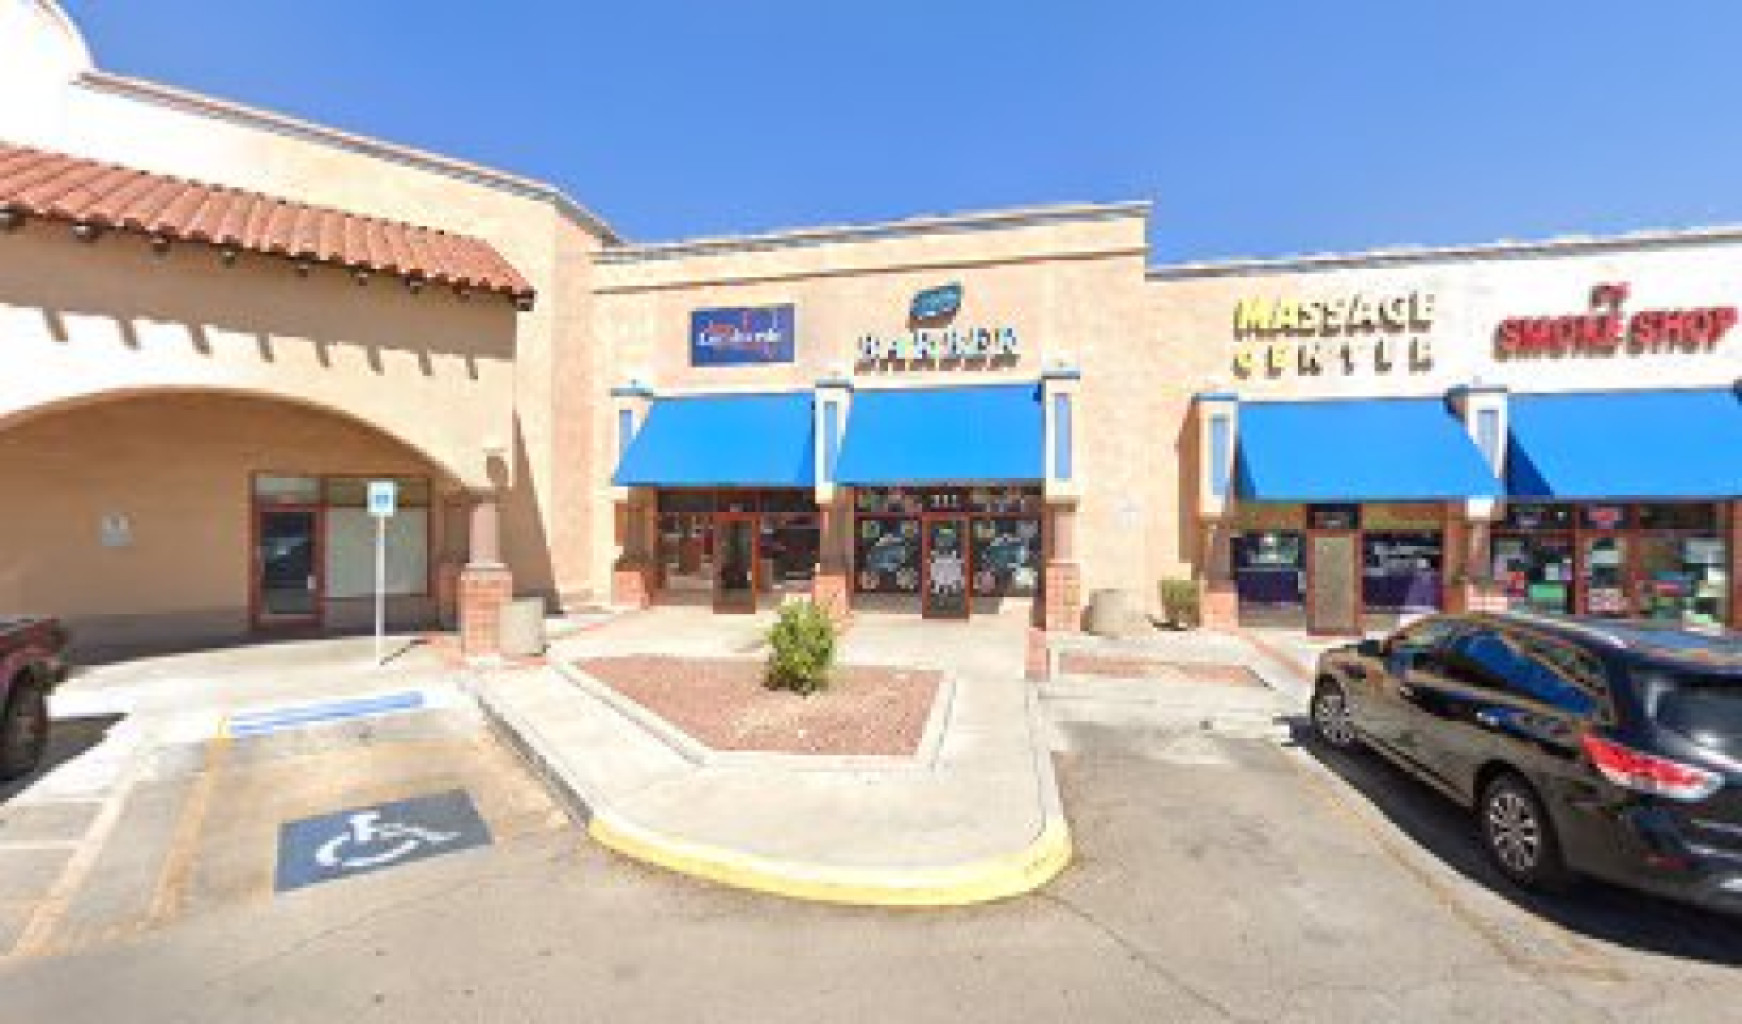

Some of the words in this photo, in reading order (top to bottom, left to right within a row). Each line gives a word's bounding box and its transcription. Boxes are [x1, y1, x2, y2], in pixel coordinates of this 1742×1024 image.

[1234, 293, 1435, 336] MASSAGE
[1493, 315, 1622, 360] SMOKE
[1626, 307, 1737, 354] SHOP
[856, 326, 1019, 366] BARBER
[1233, 338, 1433, 378] CENTER
